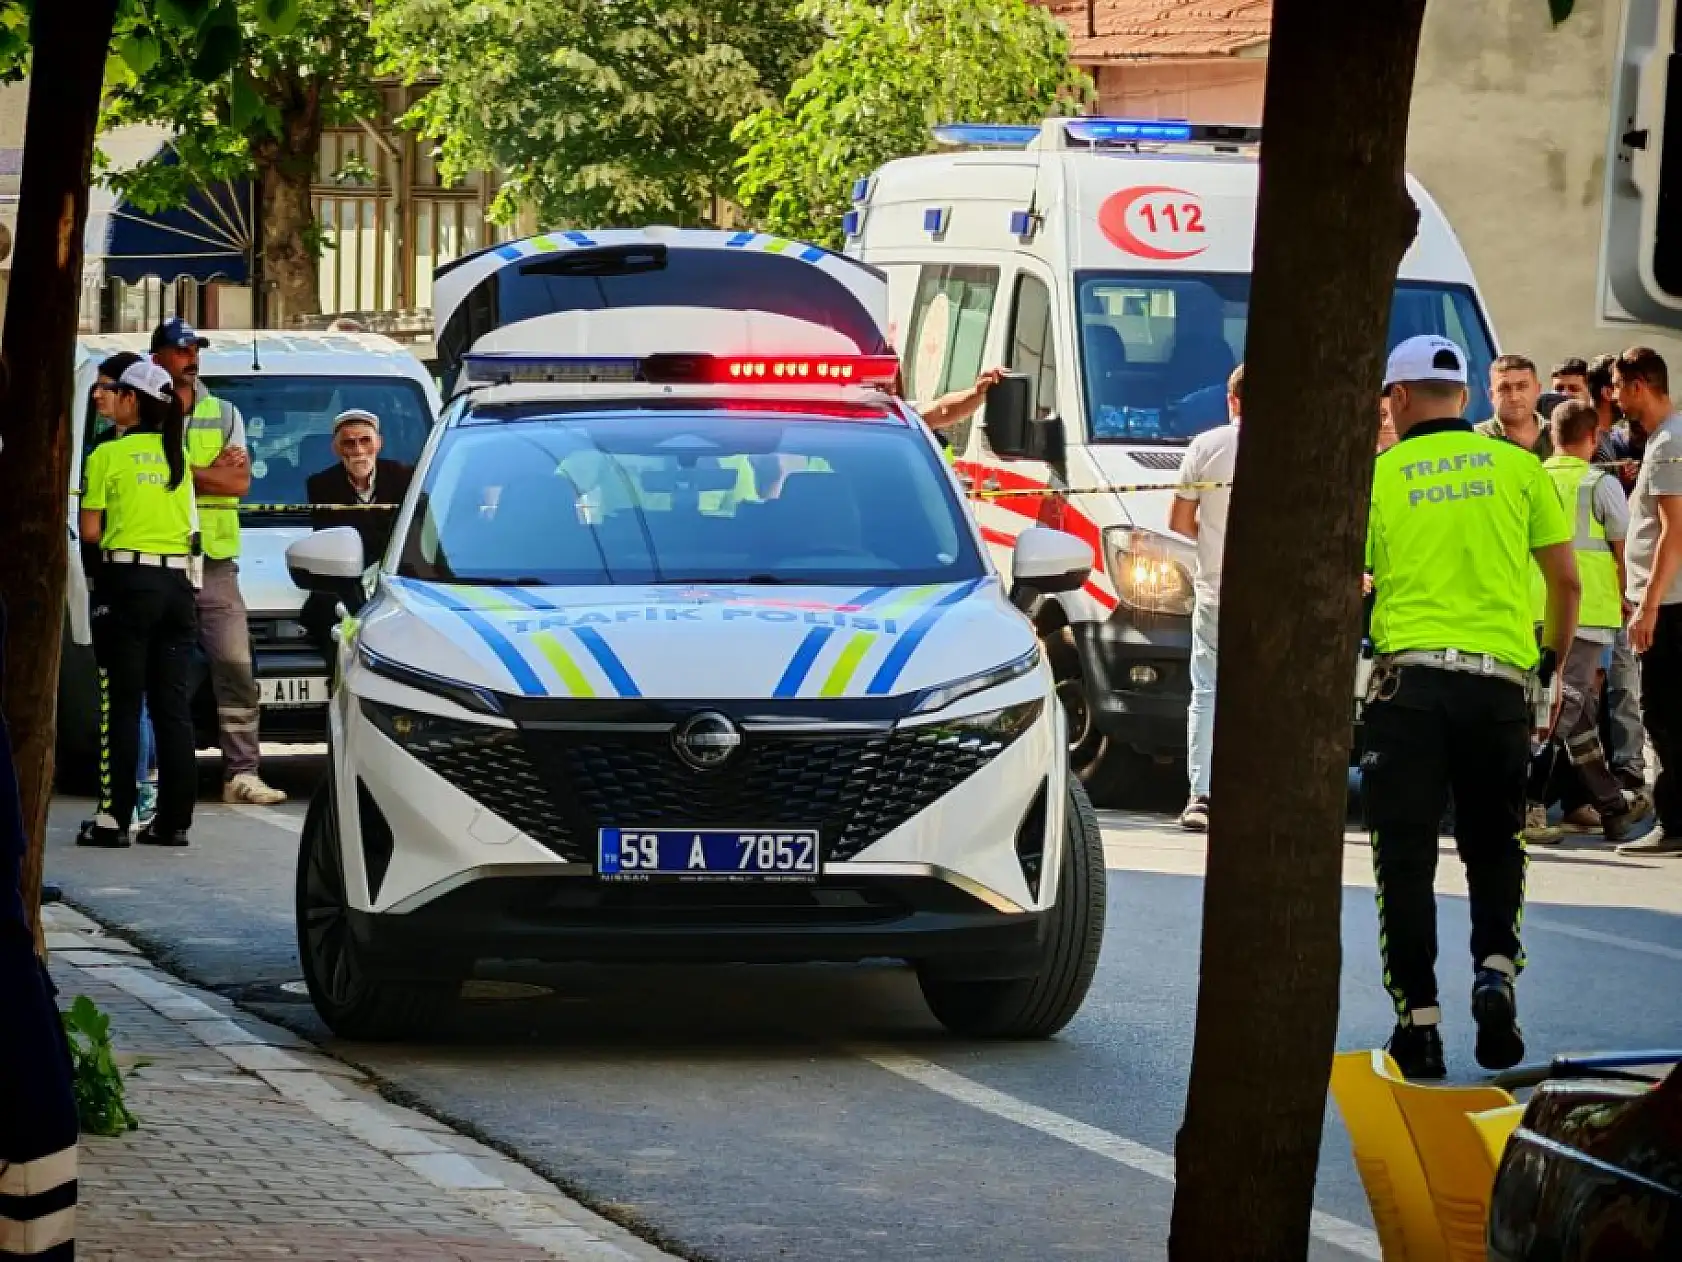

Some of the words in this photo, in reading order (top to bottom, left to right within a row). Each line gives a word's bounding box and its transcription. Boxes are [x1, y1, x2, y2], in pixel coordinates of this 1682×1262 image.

[1140, 203, 1206, 233] 112
[275, 680, 310, 702] AIH
[620, 834, 658, 869] 59
[687, 834, 707, 869] A
[736, 834, 814, 869] 7852
